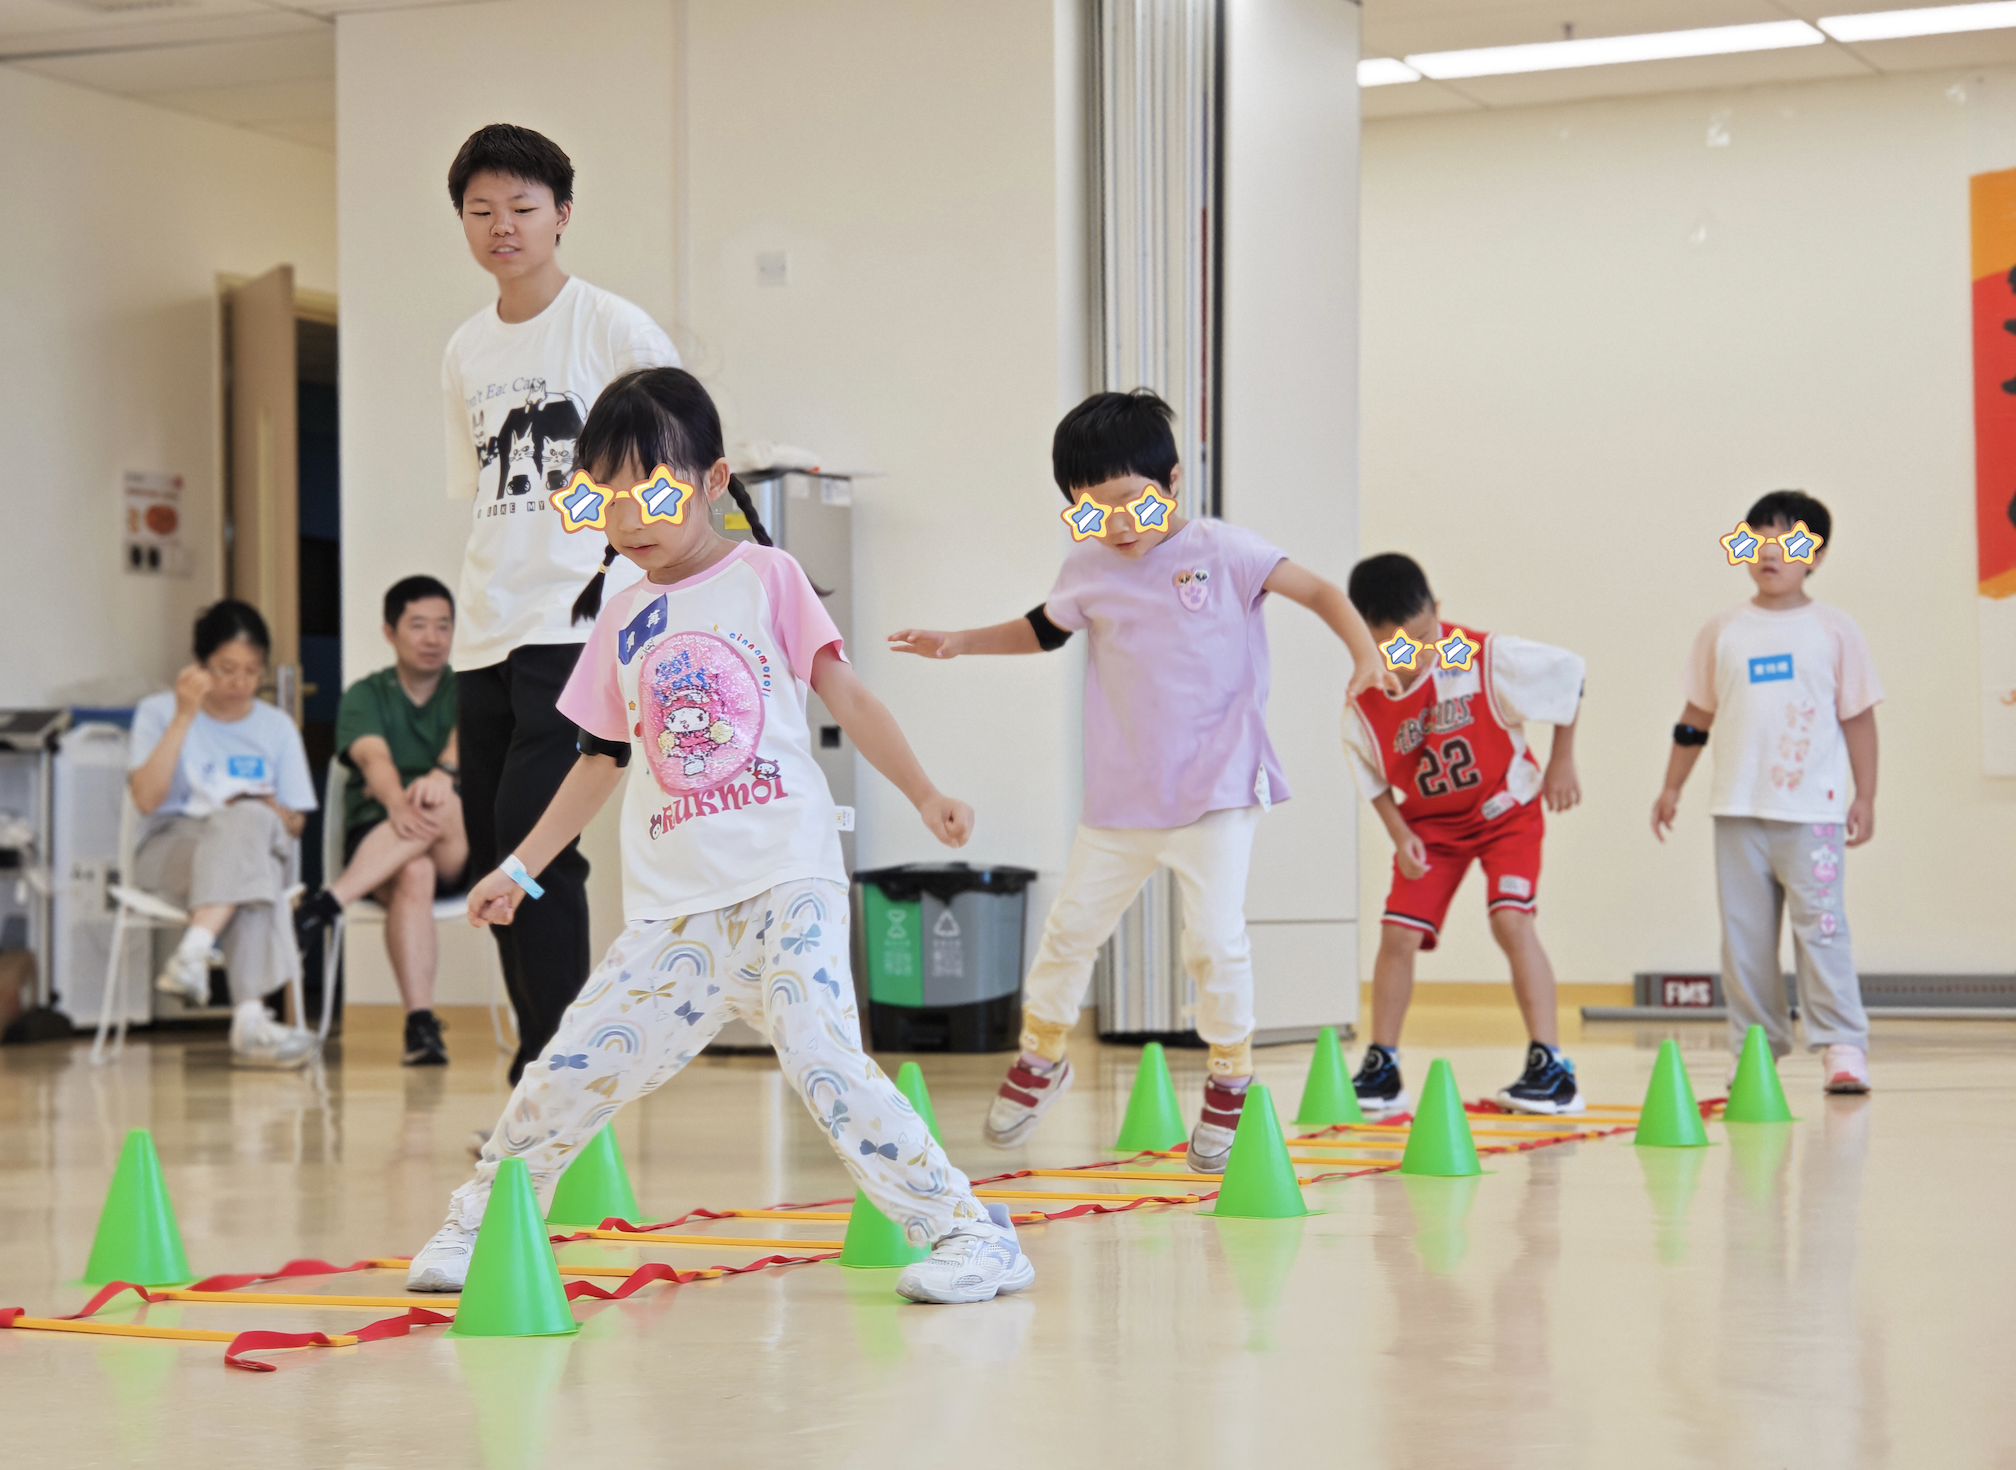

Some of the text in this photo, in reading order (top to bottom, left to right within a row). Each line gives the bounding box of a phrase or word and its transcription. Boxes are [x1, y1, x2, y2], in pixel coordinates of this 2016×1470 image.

[512, 377, 543, 393] Cats
[526, 500, 545, 512] MY
[1415, 735, 1482, 799] 22
[1665, 980, 1710, 1004] FMS
